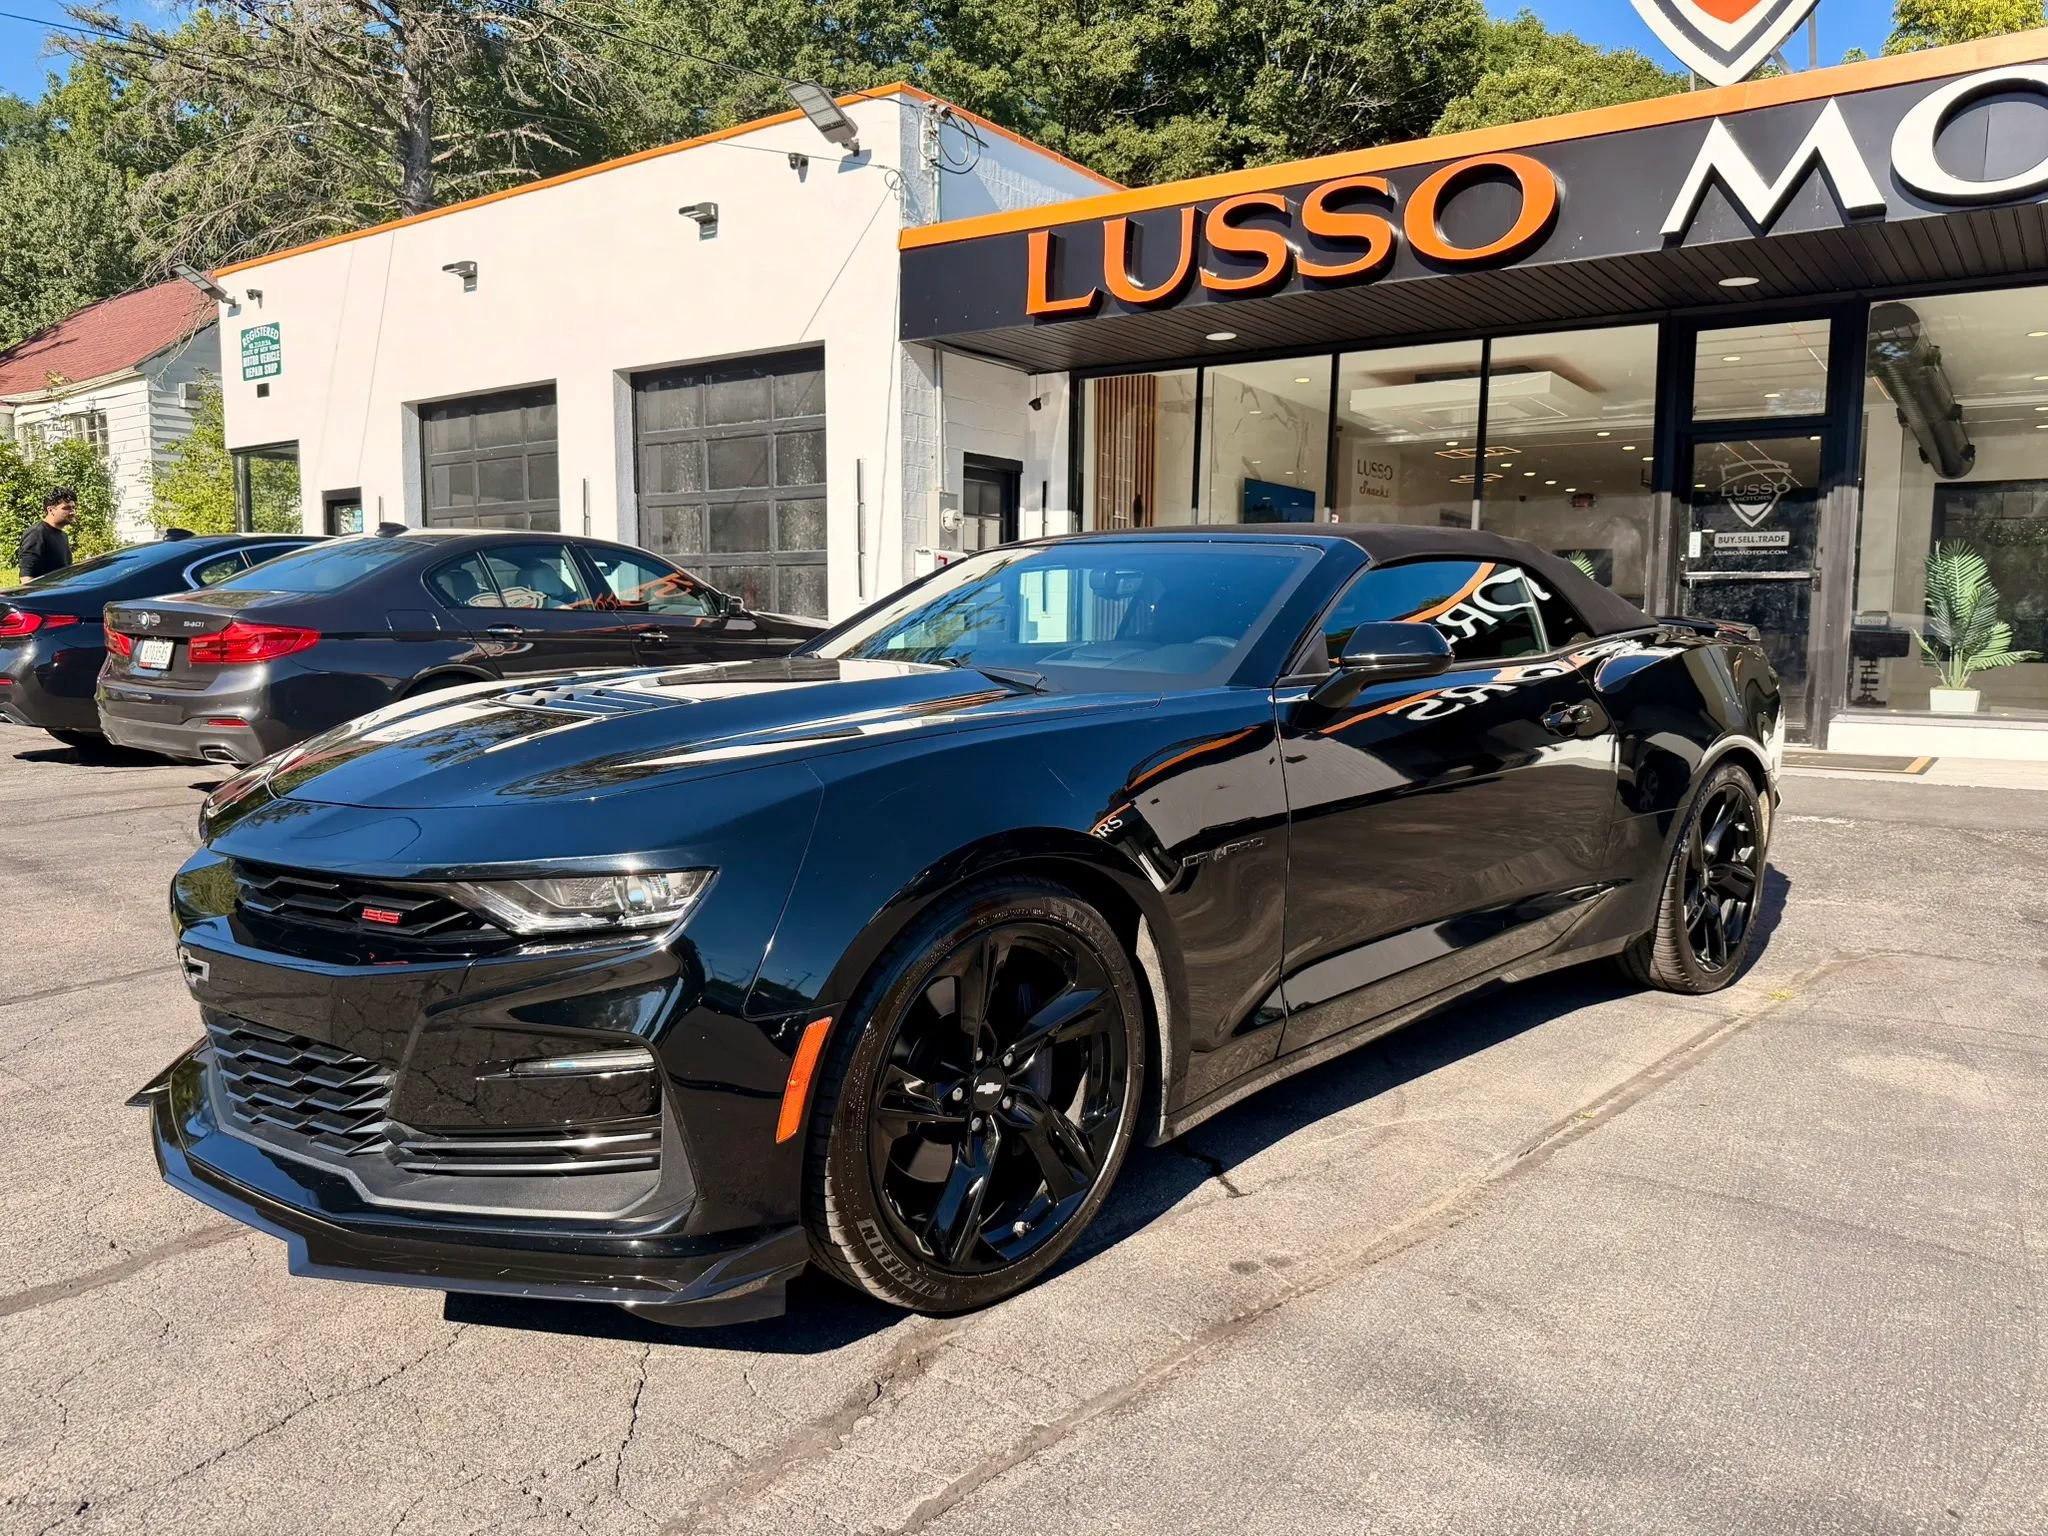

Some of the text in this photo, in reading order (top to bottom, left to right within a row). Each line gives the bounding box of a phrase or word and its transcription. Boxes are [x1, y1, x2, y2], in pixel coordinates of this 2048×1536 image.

[1026, 64, 2048, 317] LUSSO MO
[242, 326, 279, 347] REGISTERED
[260, 350, 281, 364] VEHICLE
[245, 362, 278, 379] REPAIR SHOP
[1357, 459, 1393, 481] LUSSO
[1360, 480, 1389, 498] Snacks
[1720, 482, 1791, 498] LUSSO
[860, 1223, 941, 1298] MICHELIN
